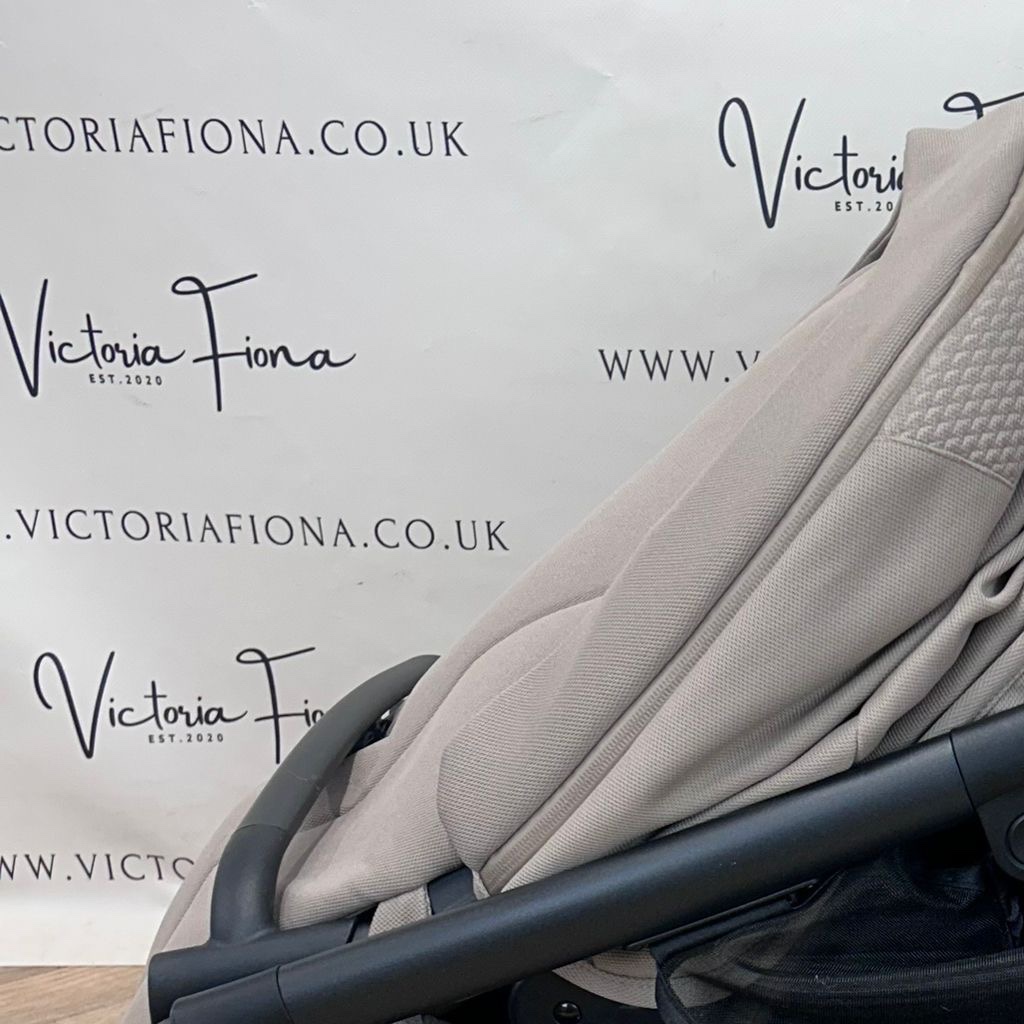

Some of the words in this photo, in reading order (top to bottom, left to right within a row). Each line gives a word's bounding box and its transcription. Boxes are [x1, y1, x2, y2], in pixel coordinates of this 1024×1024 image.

[718, 97, 902, 229] Victori
[0, 279, 185, 397] Victoria
[171, 274, 356, 412] Fiona
[89, 374, 162, 386] EST.2020
[33, 651, 248, 759] Victoria
[148, 733, 223, 743] EST.2020
